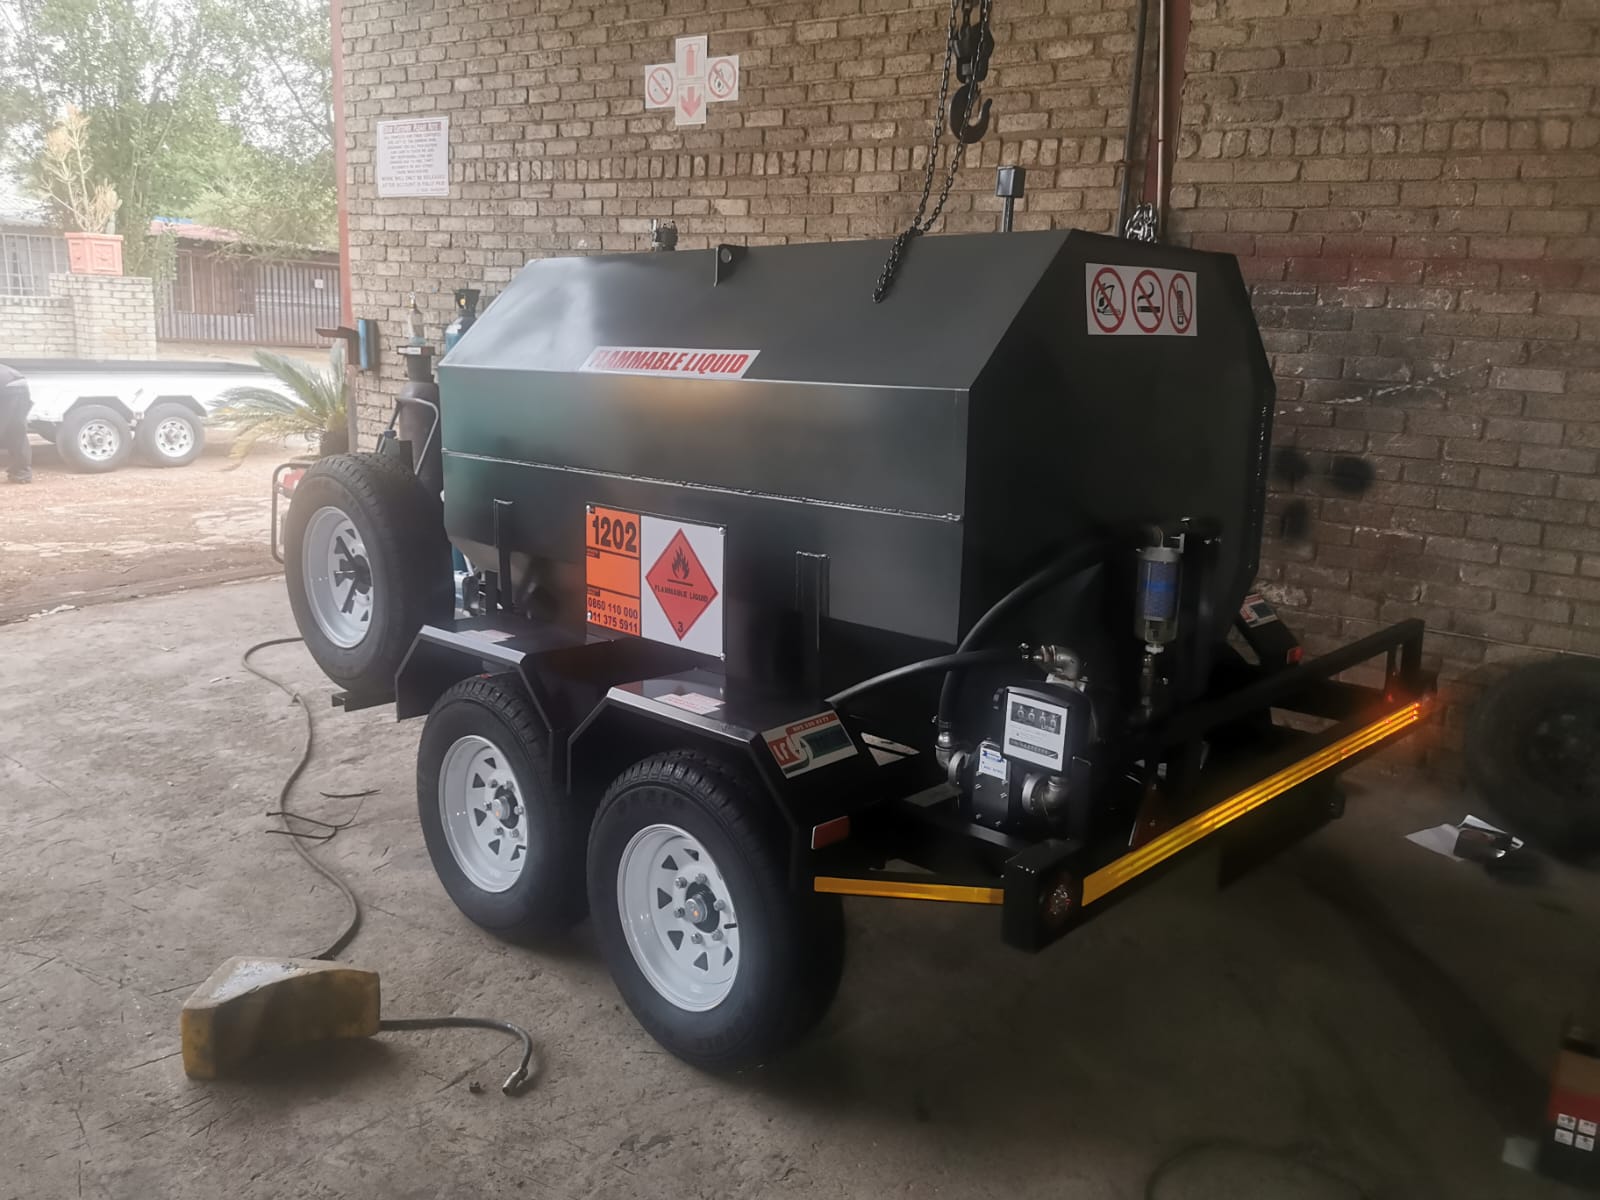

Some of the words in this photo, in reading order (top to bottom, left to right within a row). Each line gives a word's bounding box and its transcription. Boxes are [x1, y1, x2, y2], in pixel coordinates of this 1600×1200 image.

[590, 350, 688, 371] FLAMMABLE
[682, 353, 749, 374] LIQUID
[592, 515, 637, 553] 1202
[654, 585, 687, 598] FLAMMABLE
[588, 597, 606, 610] 0860
[608, 603, 622, 615] 110
[623, 607, 639, 620] 000
[603, 614, 617, 629] 375
[619, 618, 638, 633] 5911
[677, 621, 684, 633] 3
